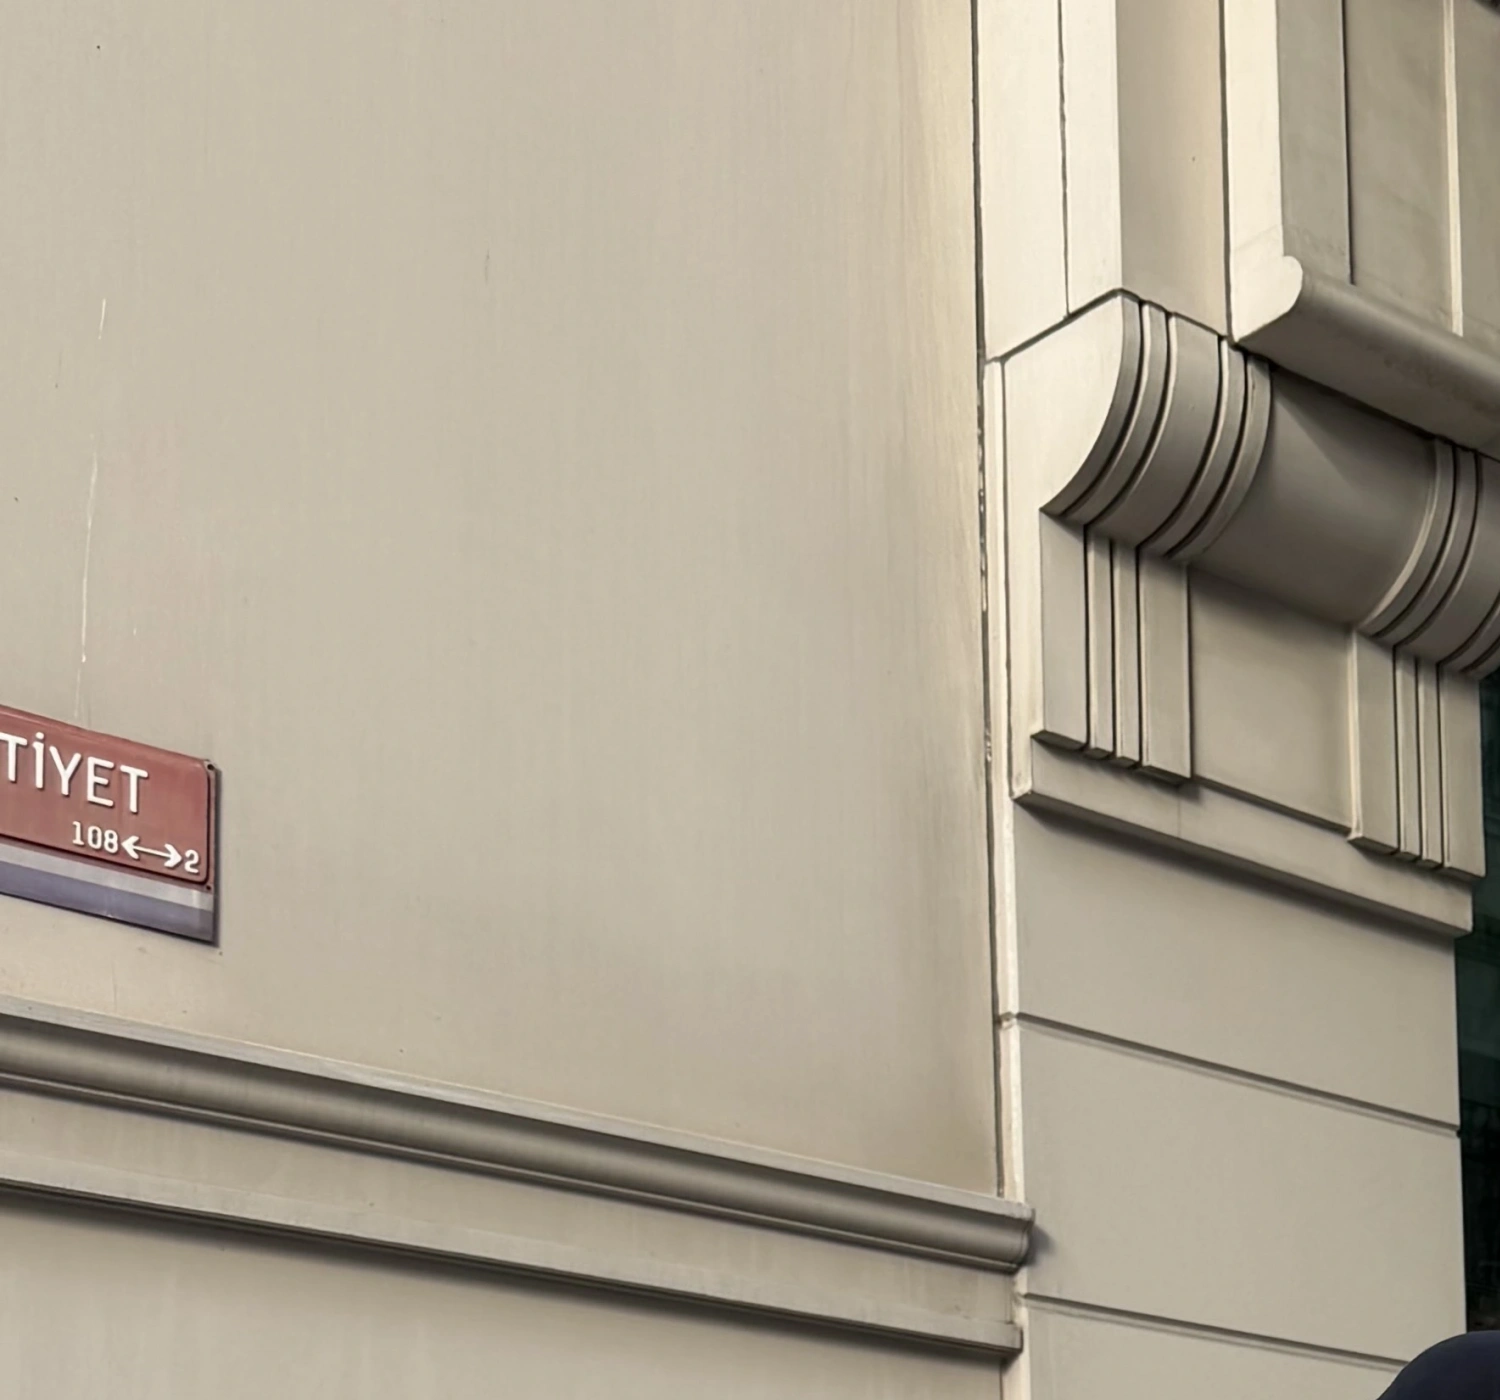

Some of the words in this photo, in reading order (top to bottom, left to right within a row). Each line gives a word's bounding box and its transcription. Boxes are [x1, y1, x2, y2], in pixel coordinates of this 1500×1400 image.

[0, 731, 149, 812] TİYET
[72, 821, 119, 852] 108
[184, 849, 200, 873] 2
